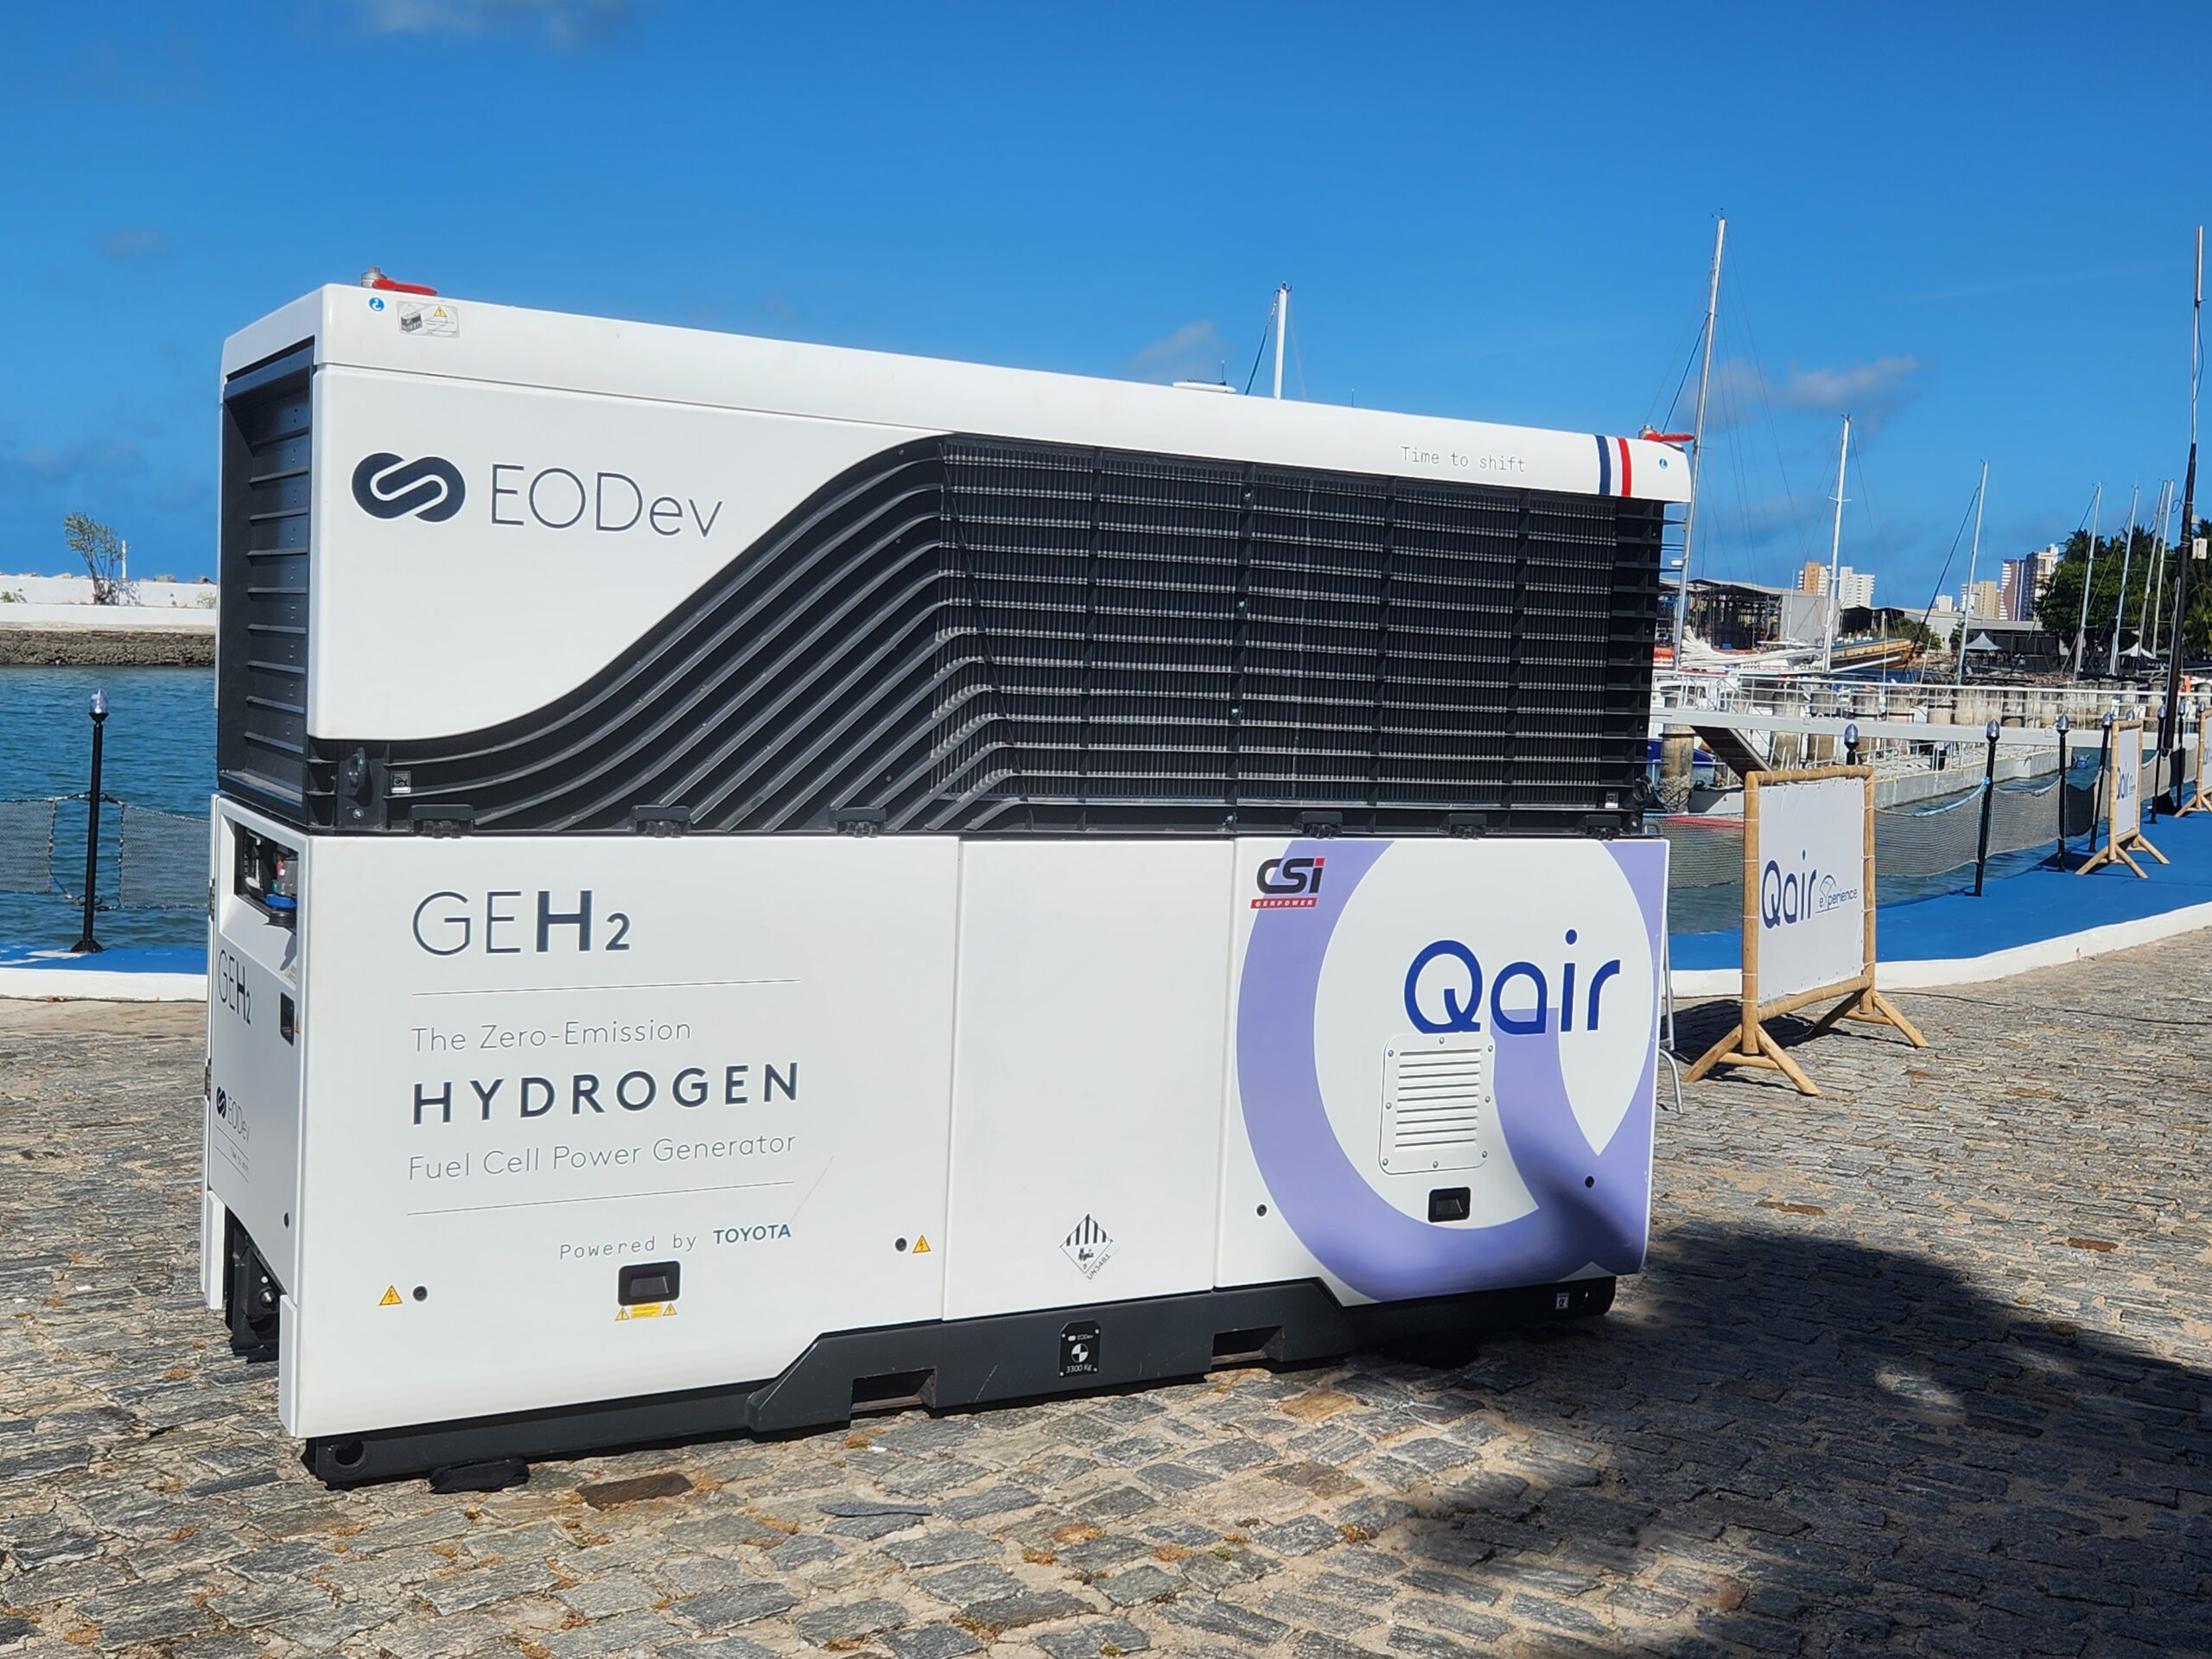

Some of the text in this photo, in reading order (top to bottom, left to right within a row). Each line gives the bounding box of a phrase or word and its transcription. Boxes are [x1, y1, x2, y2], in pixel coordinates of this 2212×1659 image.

[1401, 445, 1526, 473] Time to shift
[491, 463, 723, 537] EODev
[1762, 849, 1817, 929] Qair
[1404, 928, 1621, 1035] Qair
[411, 1020, 691, 1052] The Zero-Emission
[413, 1062, 798, 1125] HYDROGEN
[410, 1135, 796, 1180] Fuel Cell Power Generator
[560, 1224, 792, 1260] Powered by TOYOTA
[1087, 1254, 1111, 1280] UN3481
[1066, 1364, 1083, 1374] 3300
